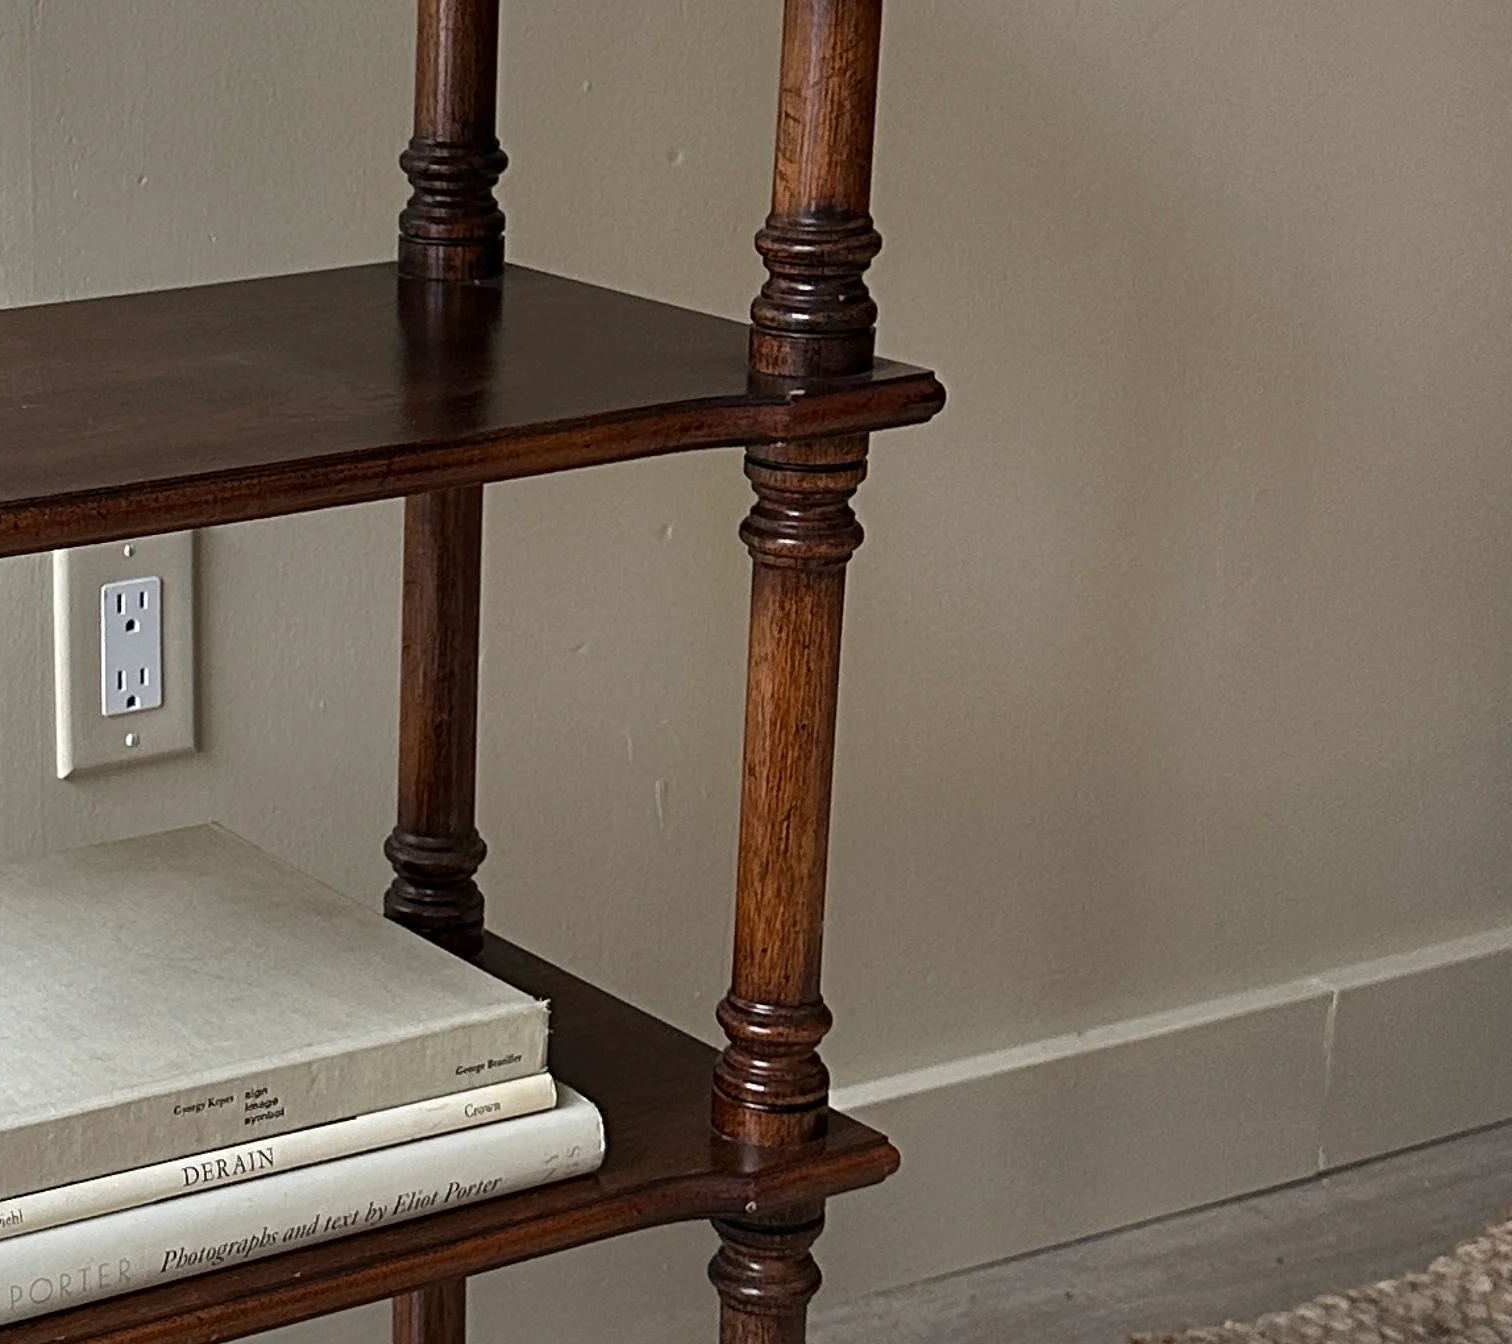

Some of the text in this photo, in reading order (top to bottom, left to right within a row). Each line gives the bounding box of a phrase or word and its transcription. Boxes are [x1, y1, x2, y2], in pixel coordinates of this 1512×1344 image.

[464, 1102, 501, 1118] Crown
[181, 1147, 274, 1187] DERAIN
[160, 1177, 503, 1273] Photographs and text by Eliot Porter
[10, 1258, 131, 1310] PORTER
